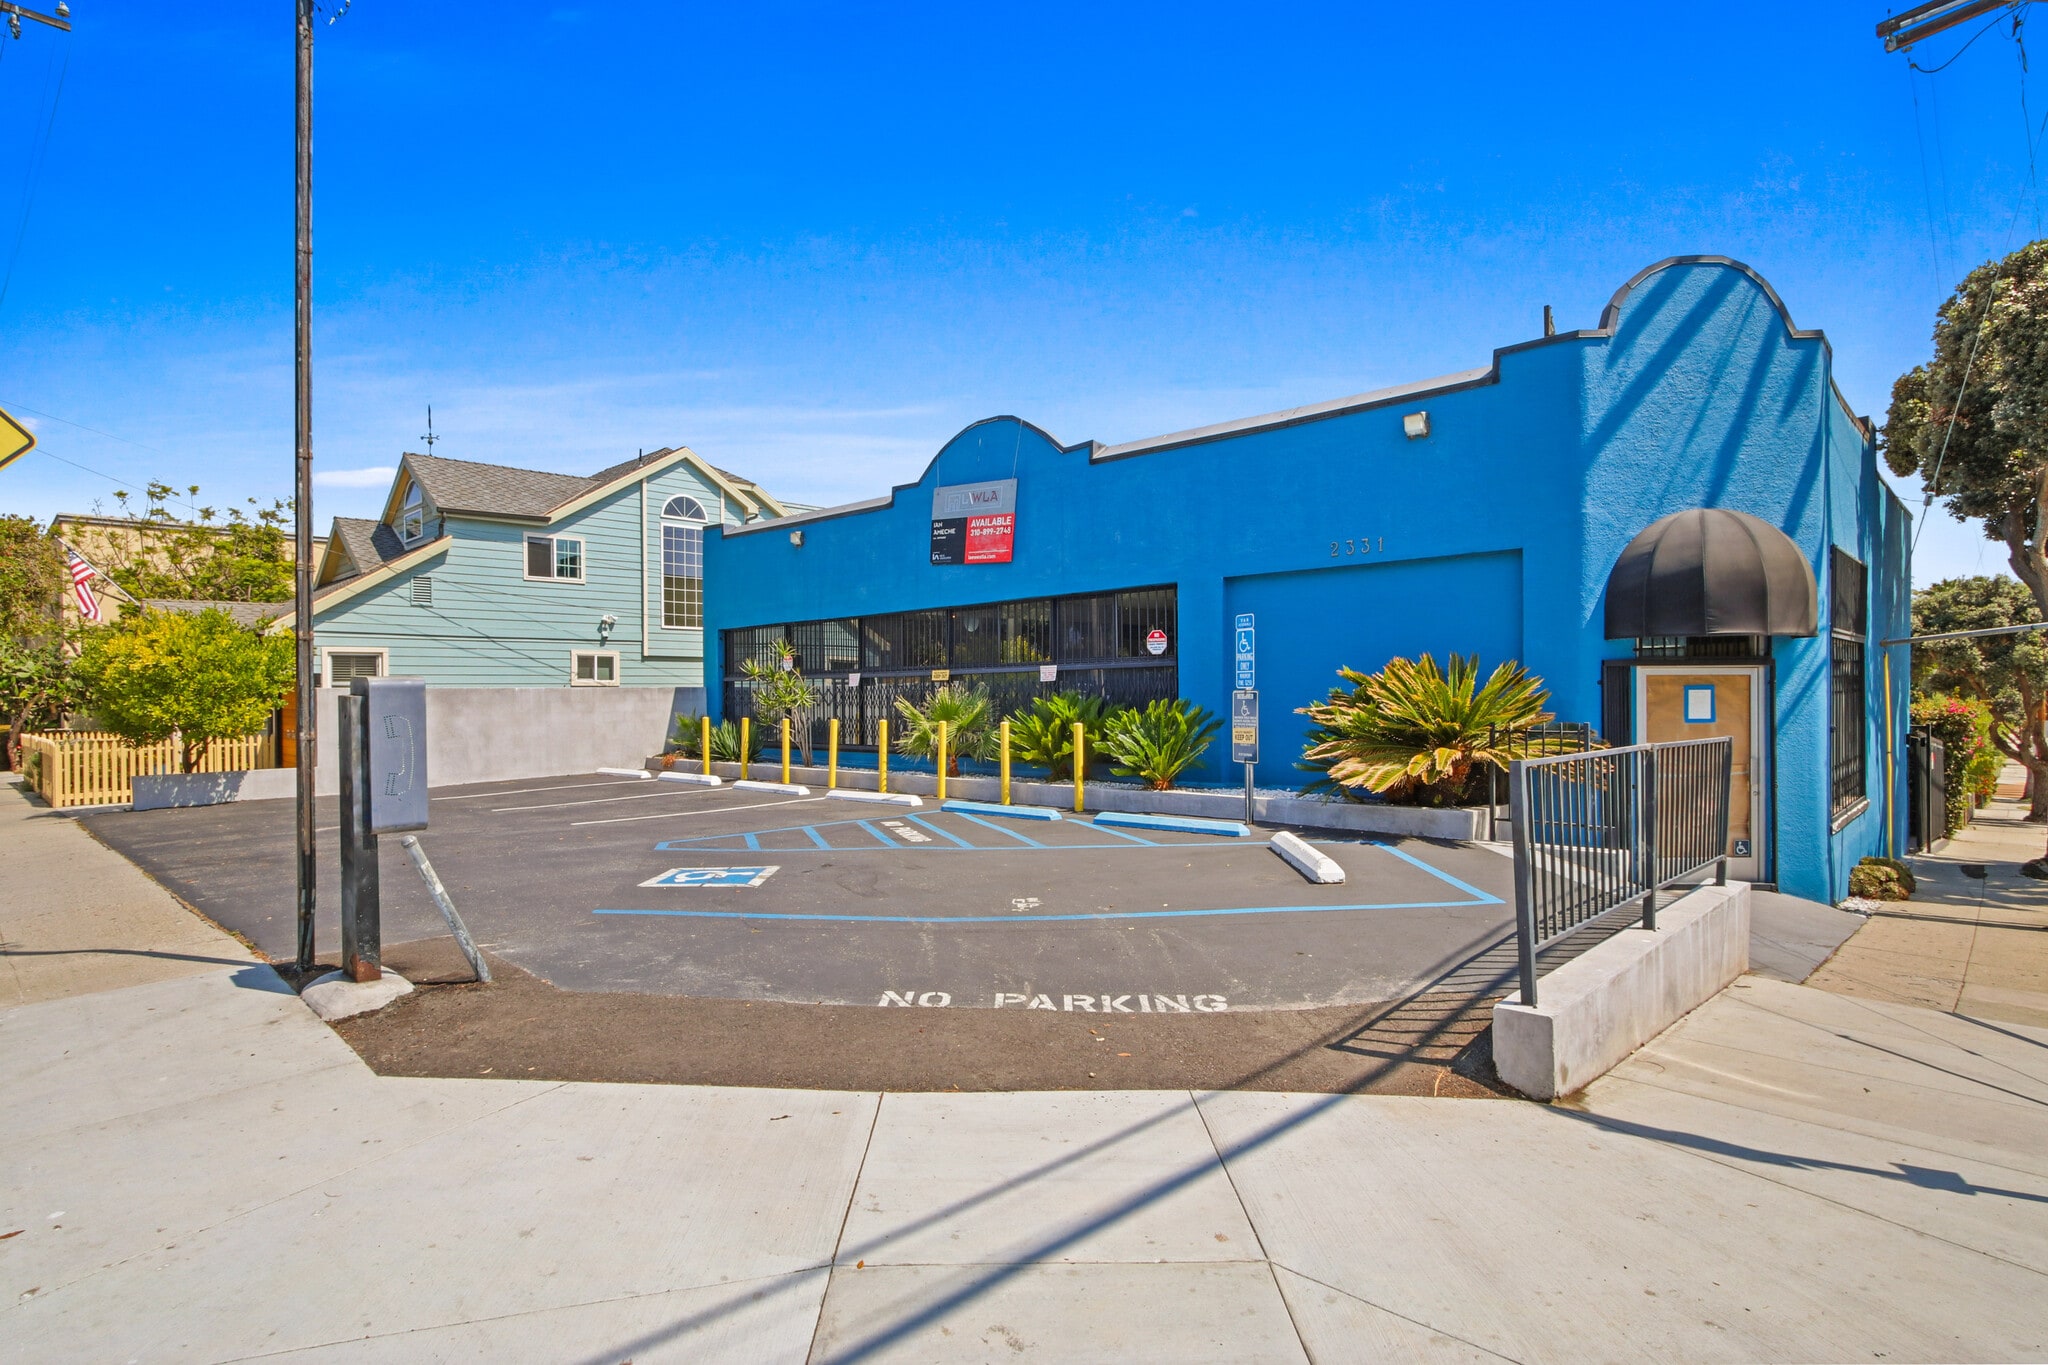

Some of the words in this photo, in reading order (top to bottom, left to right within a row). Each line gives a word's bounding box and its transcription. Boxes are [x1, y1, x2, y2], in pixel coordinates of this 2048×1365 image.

[971, 516, 1012, 527] AVAILABLE
[1330, 536, 1384, 557] 2331
[1236, 652, 1253, 661] PARKING
[1245, 733, 1253, 741] OUT
[878, 990, 951, 1008] NO
[994, 992, 1229, 1013] PARKING
